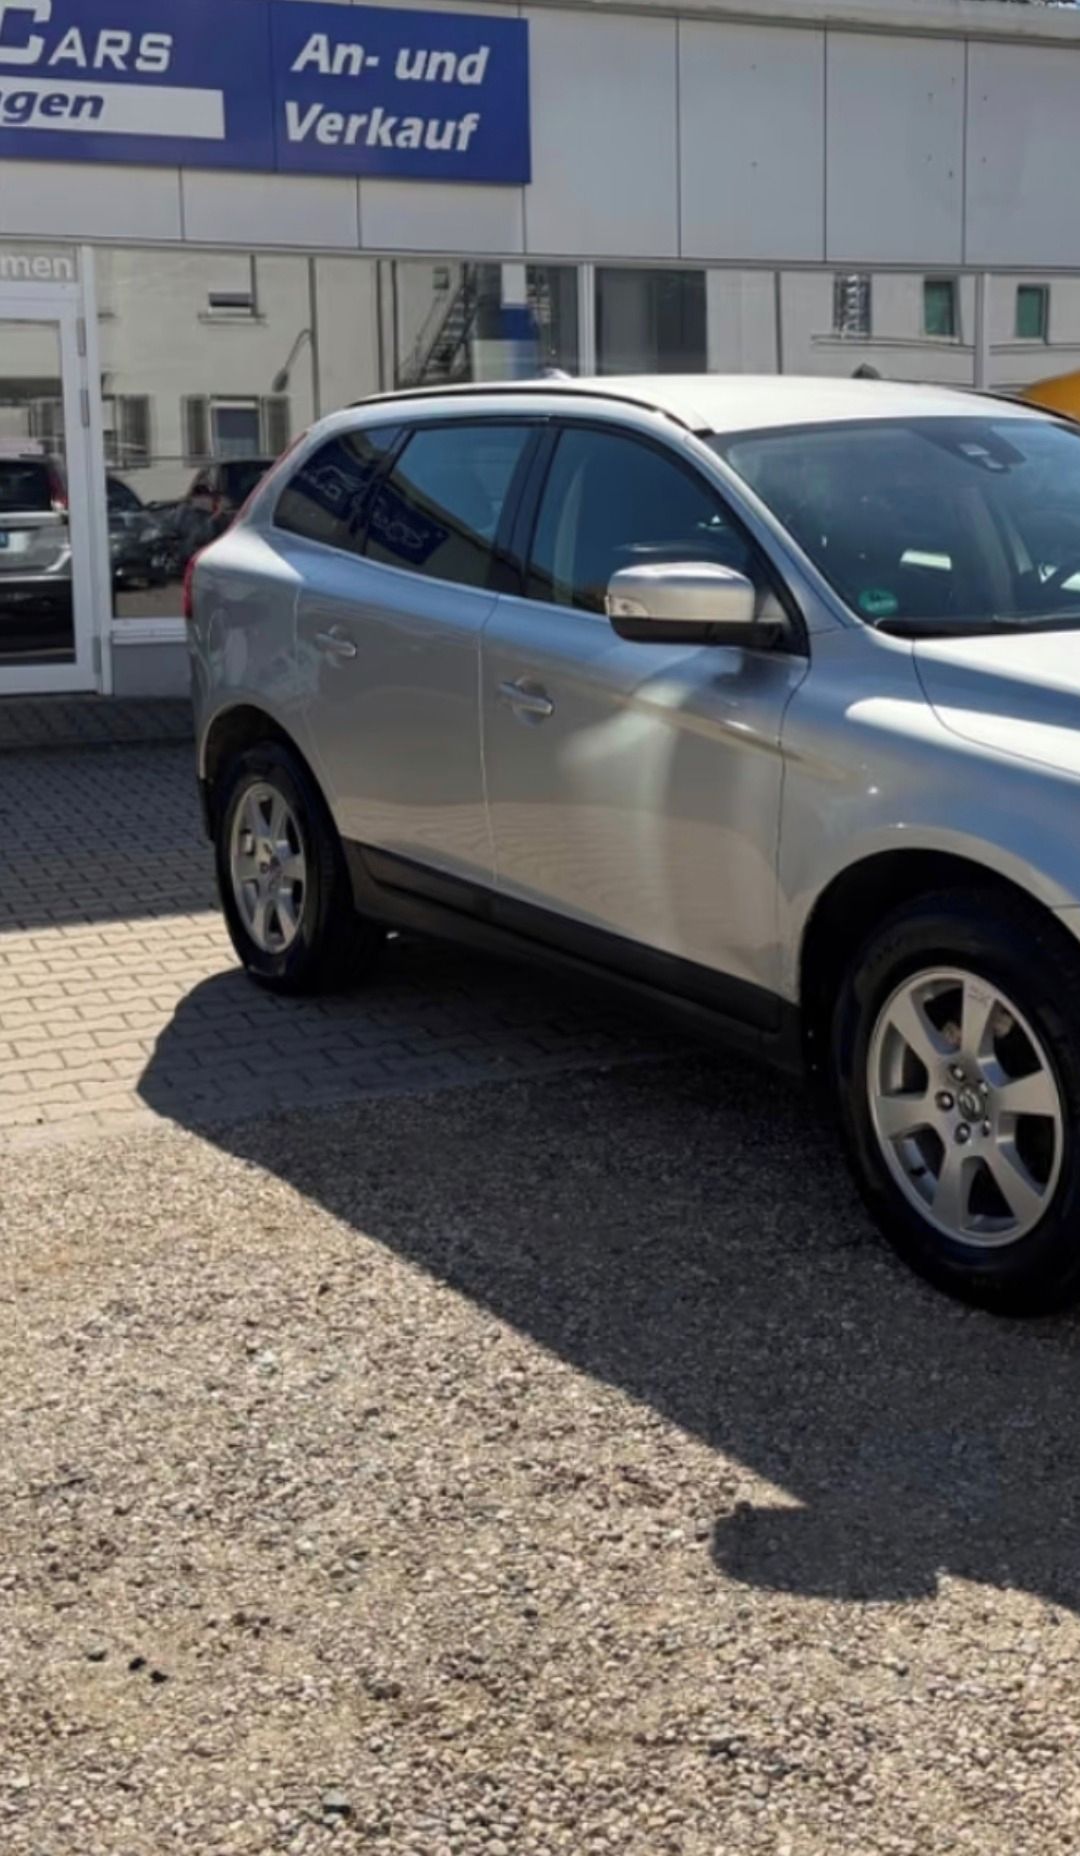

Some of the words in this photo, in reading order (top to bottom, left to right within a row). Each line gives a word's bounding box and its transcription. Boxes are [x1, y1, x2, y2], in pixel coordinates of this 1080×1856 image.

[290, 33, 380, 76] An-
[395, 45, 490, 85] und
[0, 90, 104, 125] gen
[285, 100, 480, 151] Verkauf
